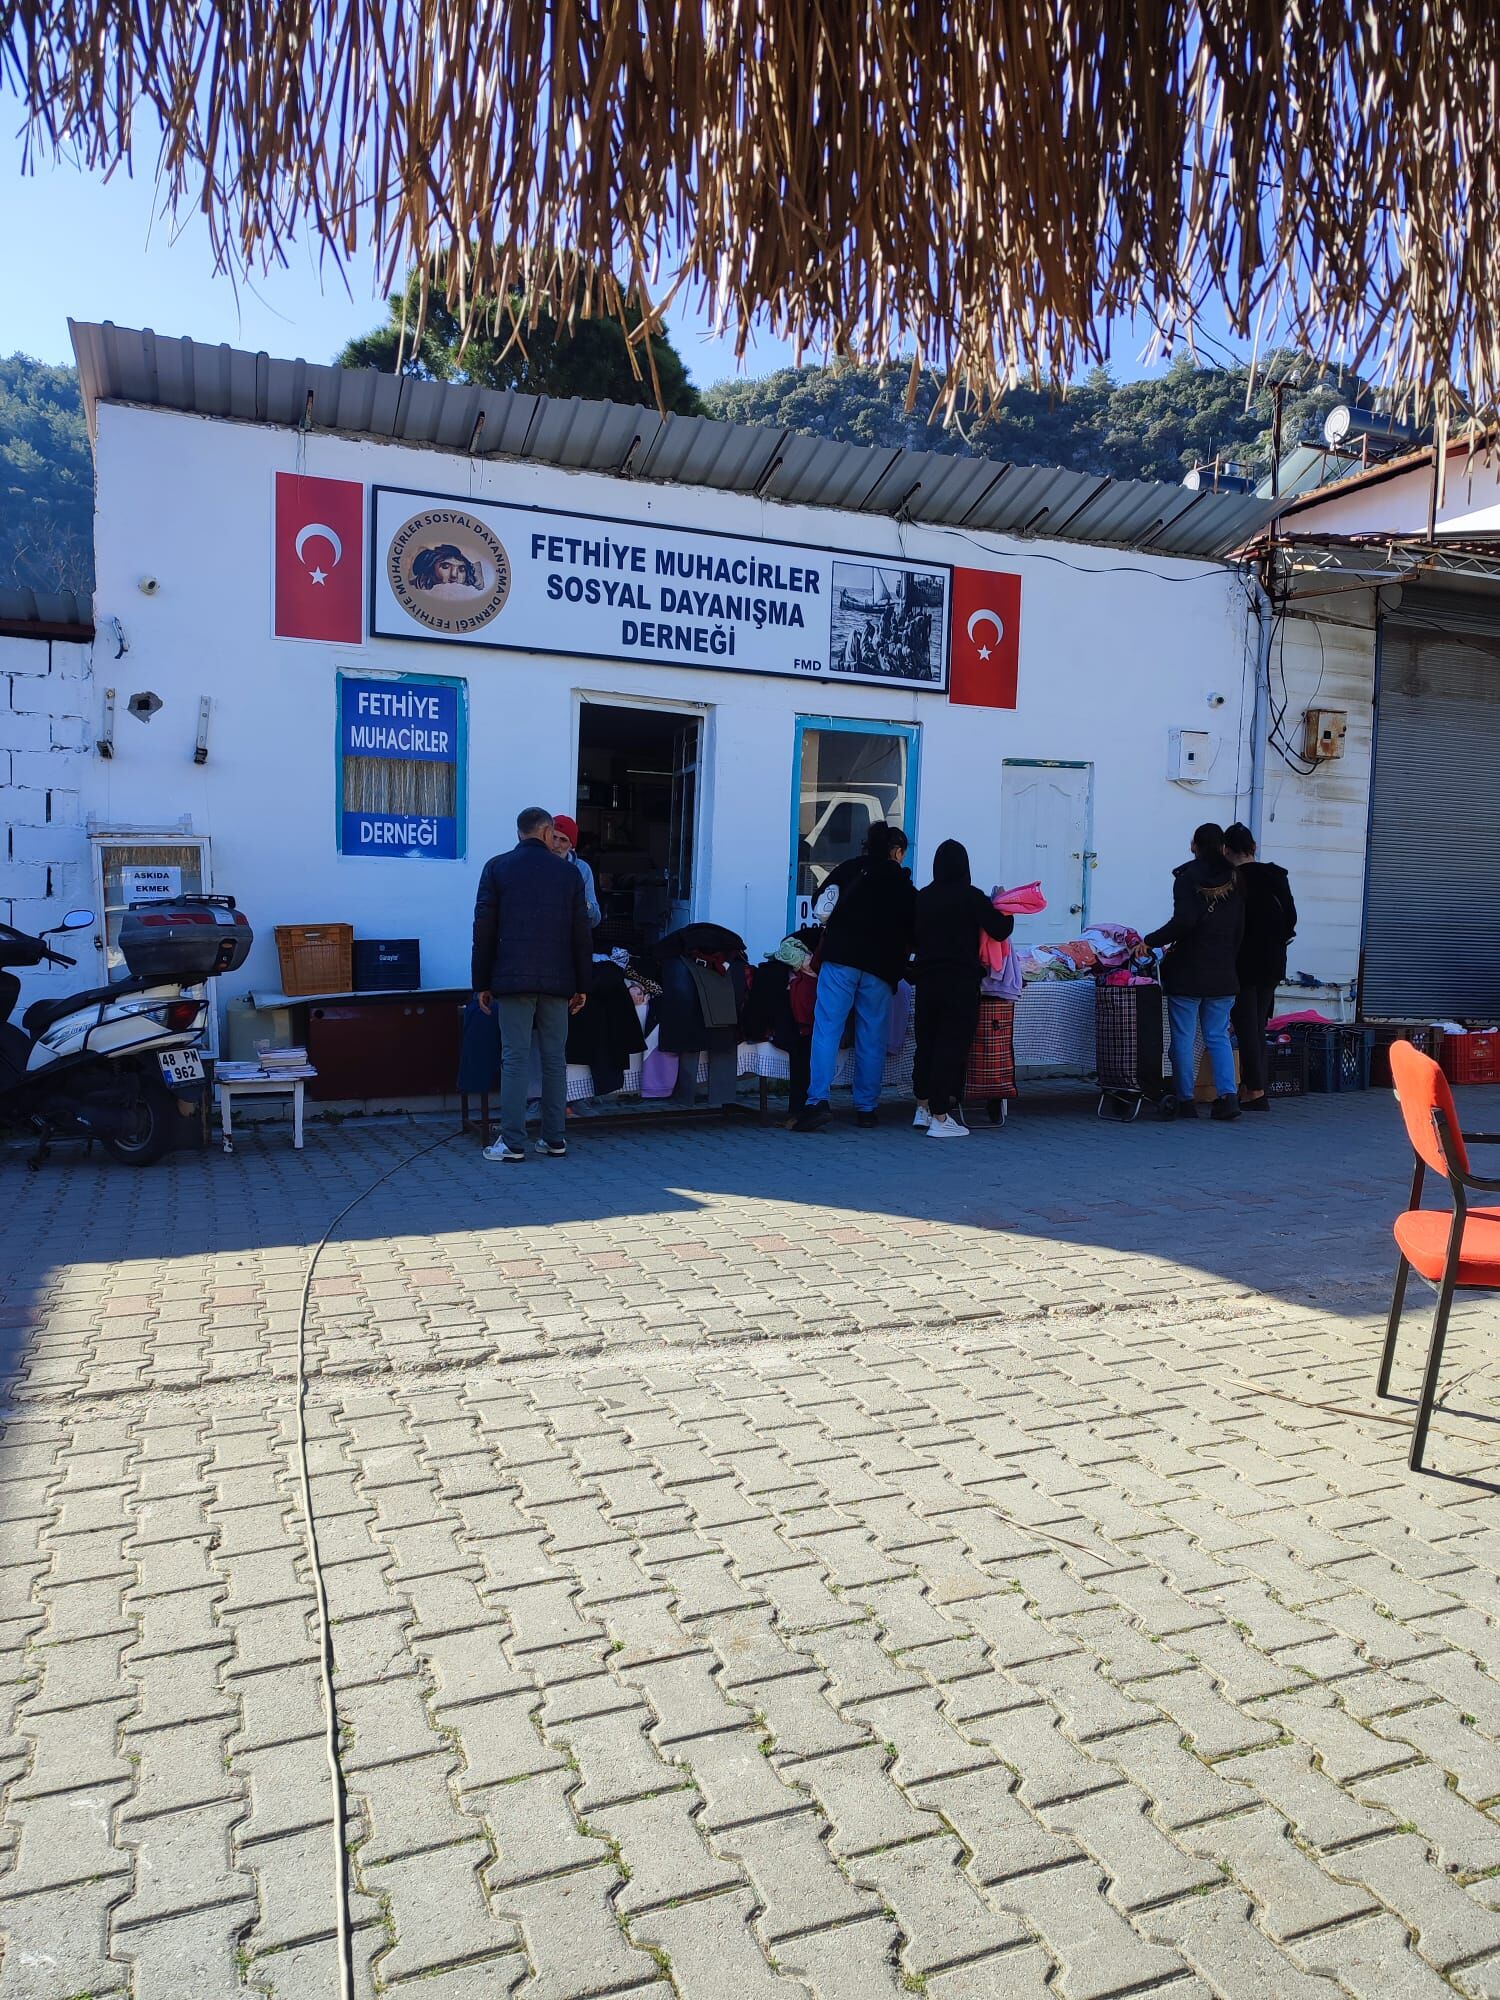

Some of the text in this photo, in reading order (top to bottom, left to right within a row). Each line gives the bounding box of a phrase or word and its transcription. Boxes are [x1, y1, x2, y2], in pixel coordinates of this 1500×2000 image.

[391, 513, 507, 631] FETHİYE MUHACİRLER SOSYAL DAYANIŞMA DERNEĞİ
[531, 533, 820, 594] FETHİYE MUHACİRLER
[546, 574, 805, 630] SOSYAL DAYANIŞMA
[622, 620, 735, 656] DERNEĞİ
[794, 658, 822, 671] FMD
[358, 690, 439, 720] FETHİYE
[351, 724, 448, 753] MUHACİRLER
[360, 818, 437, 846] DERNEĞİ
[162, 1050, 199, 1067] 48 PN
[174, 1066, 196, 1080] 962
